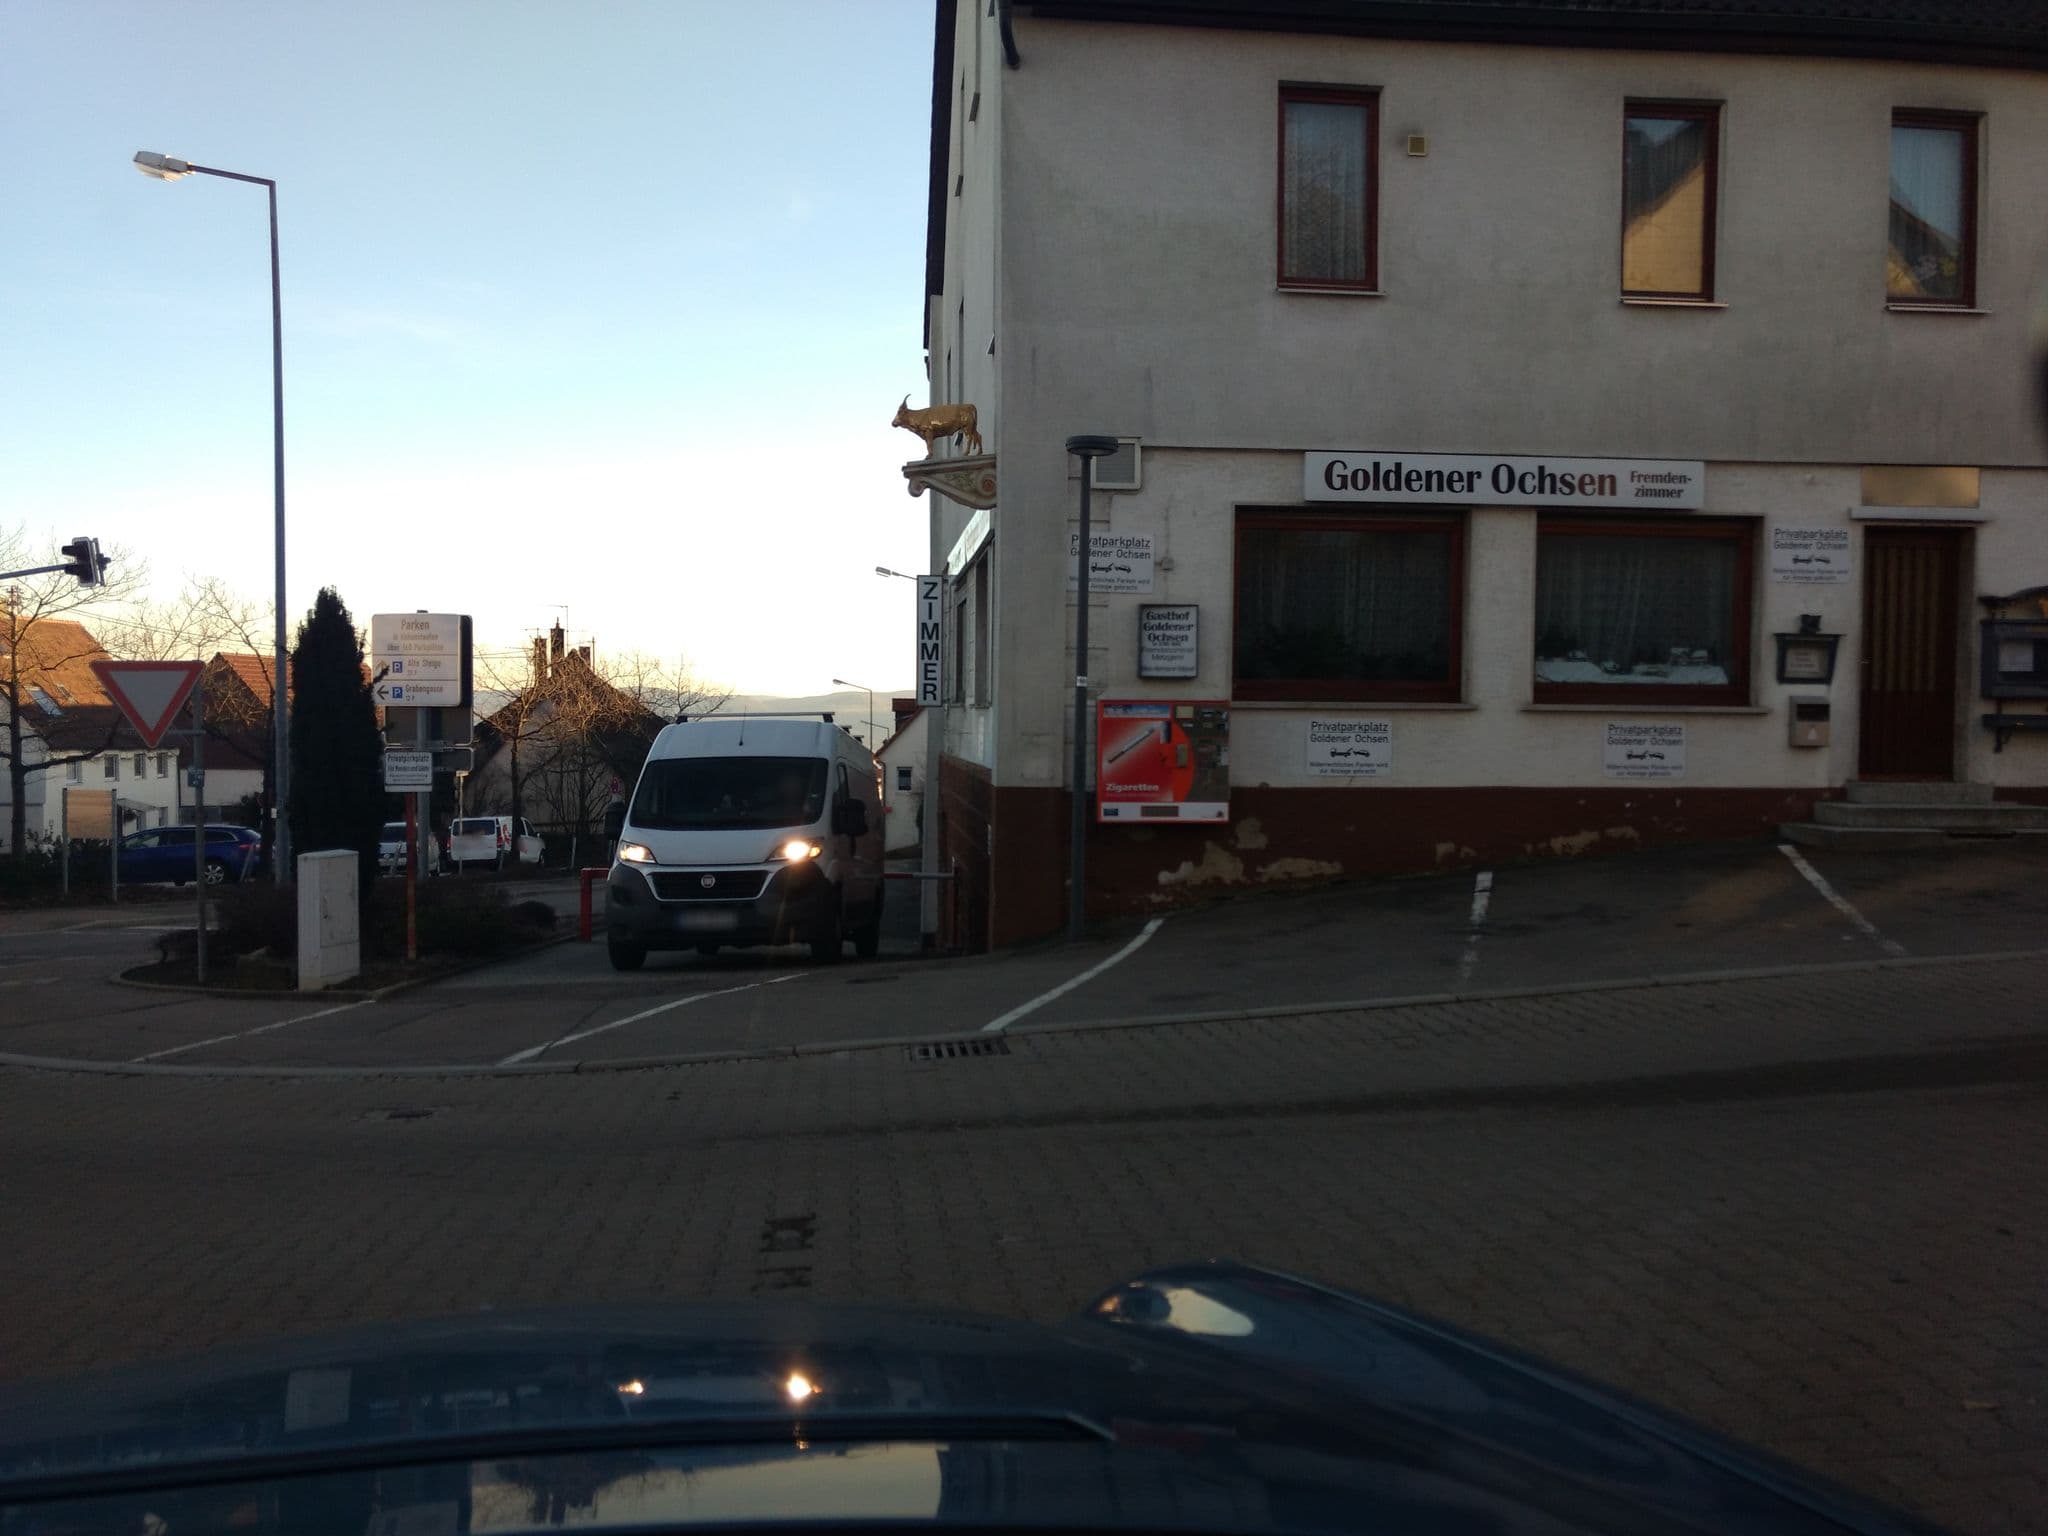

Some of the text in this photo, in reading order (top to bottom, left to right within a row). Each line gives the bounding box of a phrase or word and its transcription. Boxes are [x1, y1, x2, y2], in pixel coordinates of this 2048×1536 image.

[1324, 460, 1617, 496] Goldener Ochsen
[1630, 470, 1692, 484] Fremden-
[1634, 485, 1684, 499] zimmer
[1775, 528, 1848, 541] Privatparkplatz
[1071, 534, 1151, 549] Pvatparkplatz
[1116, 549, 1151, 559] Ochsen
[1146, 611, 1190, 621] Gasthof
[401, 619, 430, 630] Parken
[1143, 622, 1194, 632] Goldener
[920, 581, 940, 701] ZIMMER
[1147, 633, 1189, 642] Ochsen
[1311, 721, 1388, 733] Privatparkplatz
[1608, 724, 1682, 736] Privatparkplatz
[1355, 734, 1389, 743] Ochsen
[1105, 783, 1159, 792] Zigaretten
